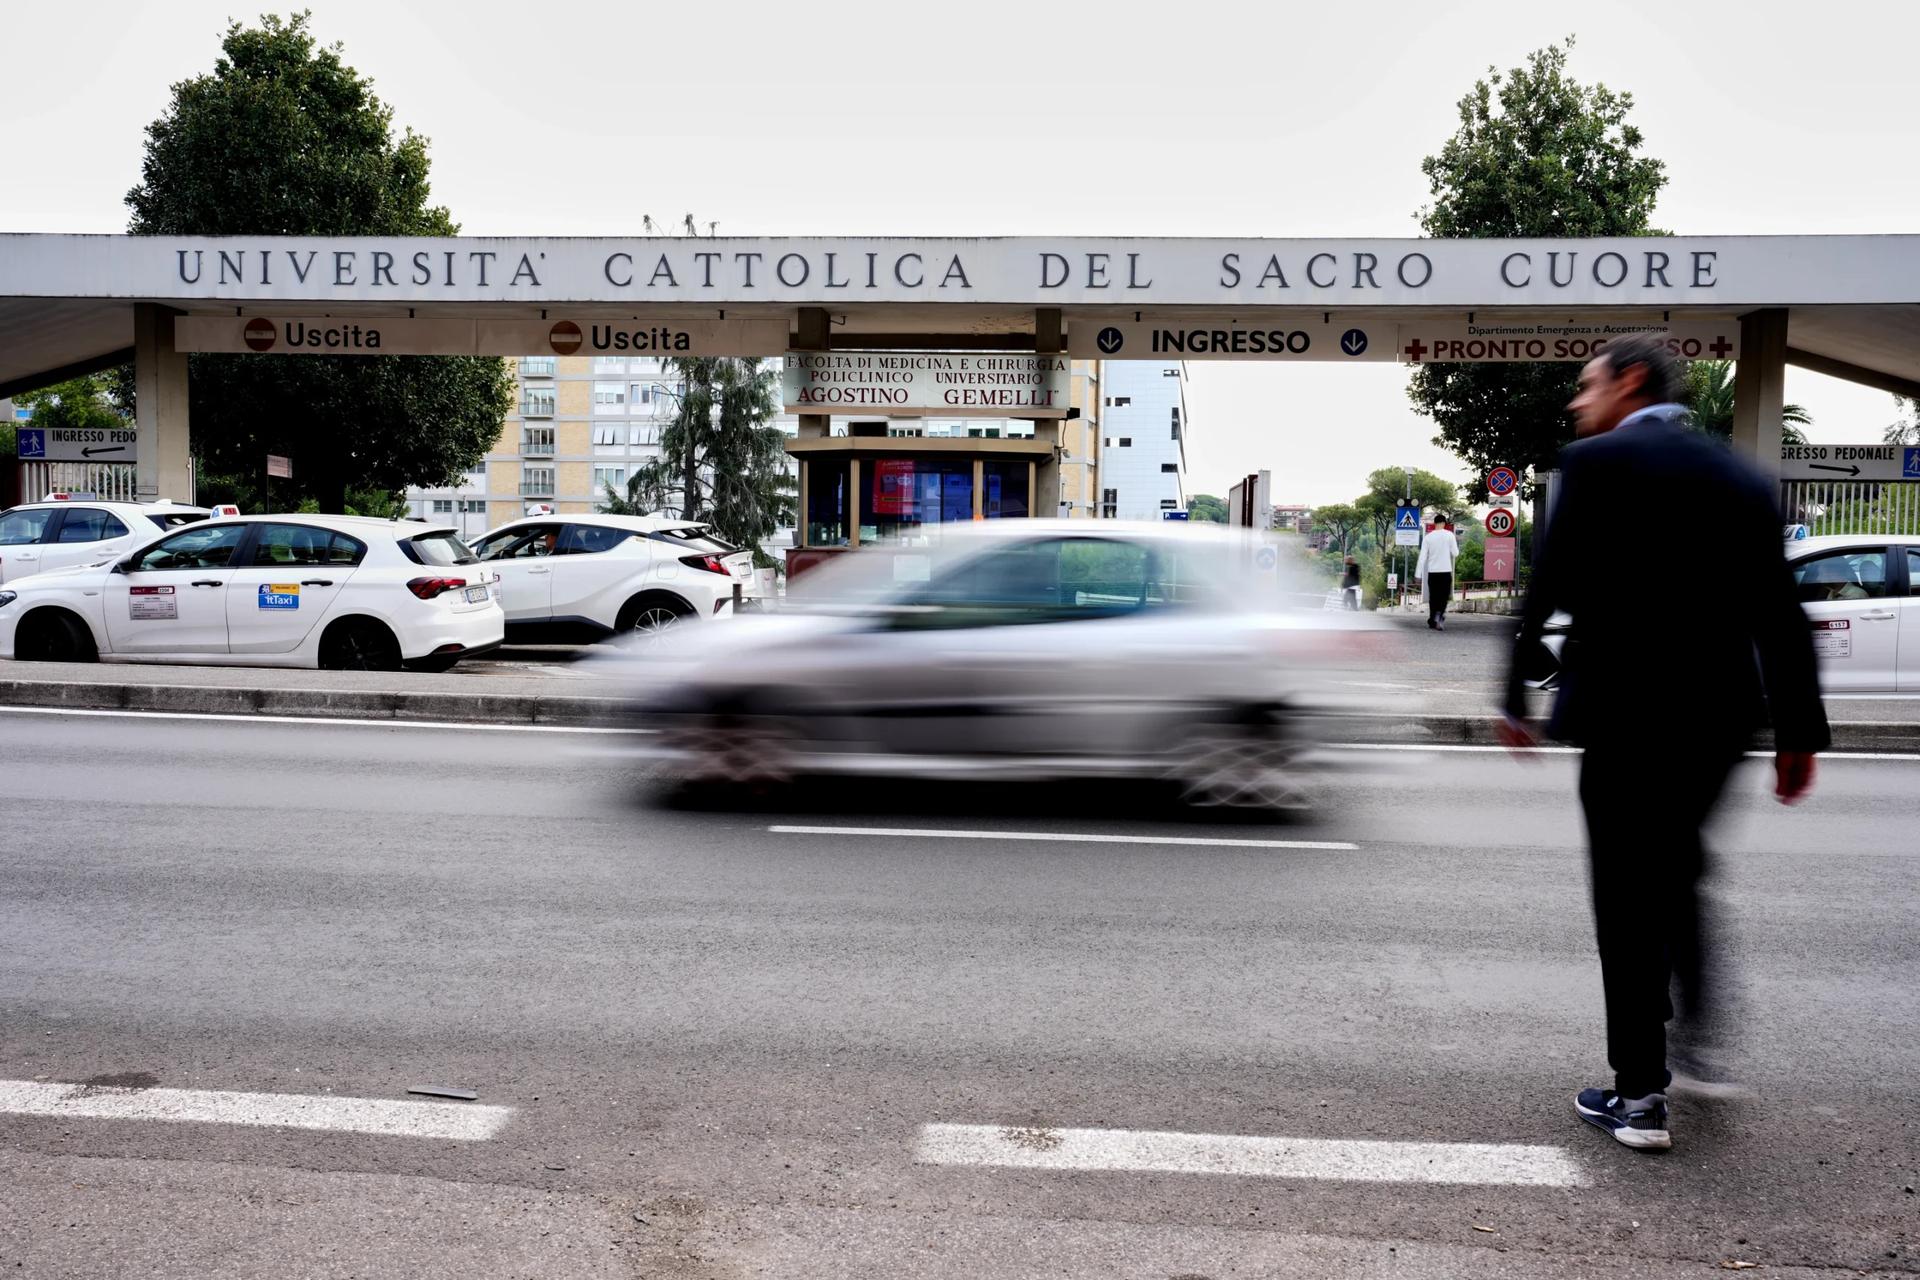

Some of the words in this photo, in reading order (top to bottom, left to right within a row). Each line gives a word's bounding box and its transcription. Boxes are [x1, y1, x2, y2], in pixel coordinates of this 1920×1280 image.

[604, 252, 973, 289] CATTOLICA
[1038, 252, 1153, 289] DEL
[1220, 252, 1433, 289] SACRO
[1500, 251, 1718, 289] CUORE
[285, 322, 381, 348] Uscita
[591, 325, 691, 351] Uscita
[1468, 326, 1535, 337] Dipartimento
[1536, 325, 1592, 336] Emergenza
[1602, 324, 1669, 335] Accettazione
[1151, 329, 1311, 354] INGRESSO
[1433, 339, 1547, 360] PRONTO
[1553, 338, 1703, 359] SOCSO
[787, 356, 852, 369] FACOLTA
[857, 356, 872, 369] DI
[878, 356, 953, 370] MEDICINA
[960, 358, 970, 371] E
[976, 358, 1067, 372] CHIRURGIA
[811, 370, 914, 384] POLICLINICO
[935, 372, 1044, 385] UNIVERSITARIO
[51, 429, 105, 443] INGRESSO
[1834, 446, 1896, 461] PEDONALE
[1491, 516, 1509, 530] 30
